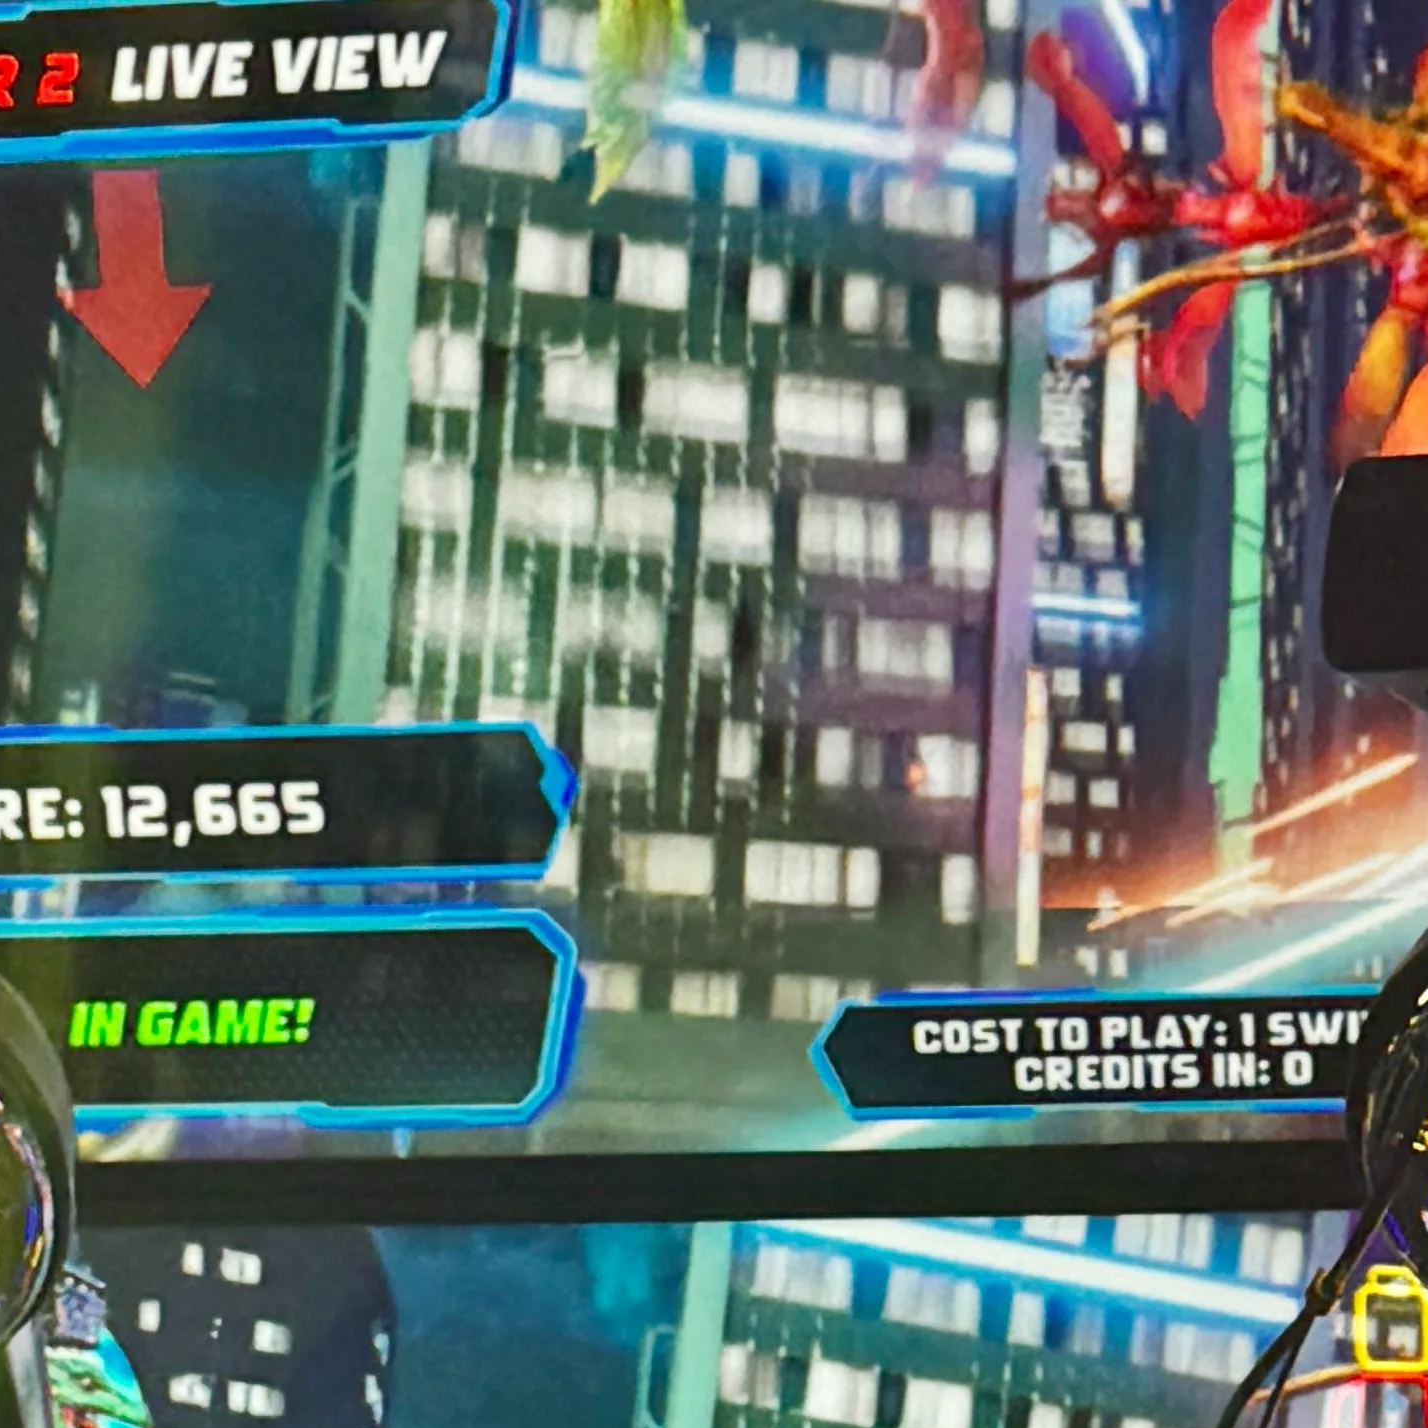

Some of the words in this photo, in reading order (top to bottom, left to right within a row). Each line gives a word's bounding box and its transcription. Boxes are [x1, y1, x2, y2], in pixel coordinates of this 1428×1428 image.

[36, 52, 80, 105] 2
[110, 41, 253, 102] LIVE
[271, 31, 448, 93] VIEW
[100, 780, 326, 847] 12,665
[69, 1001, 126, 1047] IN
[135, 998, 315, 1045] GAME!
[913, 1018, 1022, 1054] COST
[1035, 1017, 1089, 1051] TO
[1267, 1009, 1369, 1046] SWI
[1014, 1052, 1201, 1092] CREDITS
[1212, 1051, 1271, 1088] IN:
